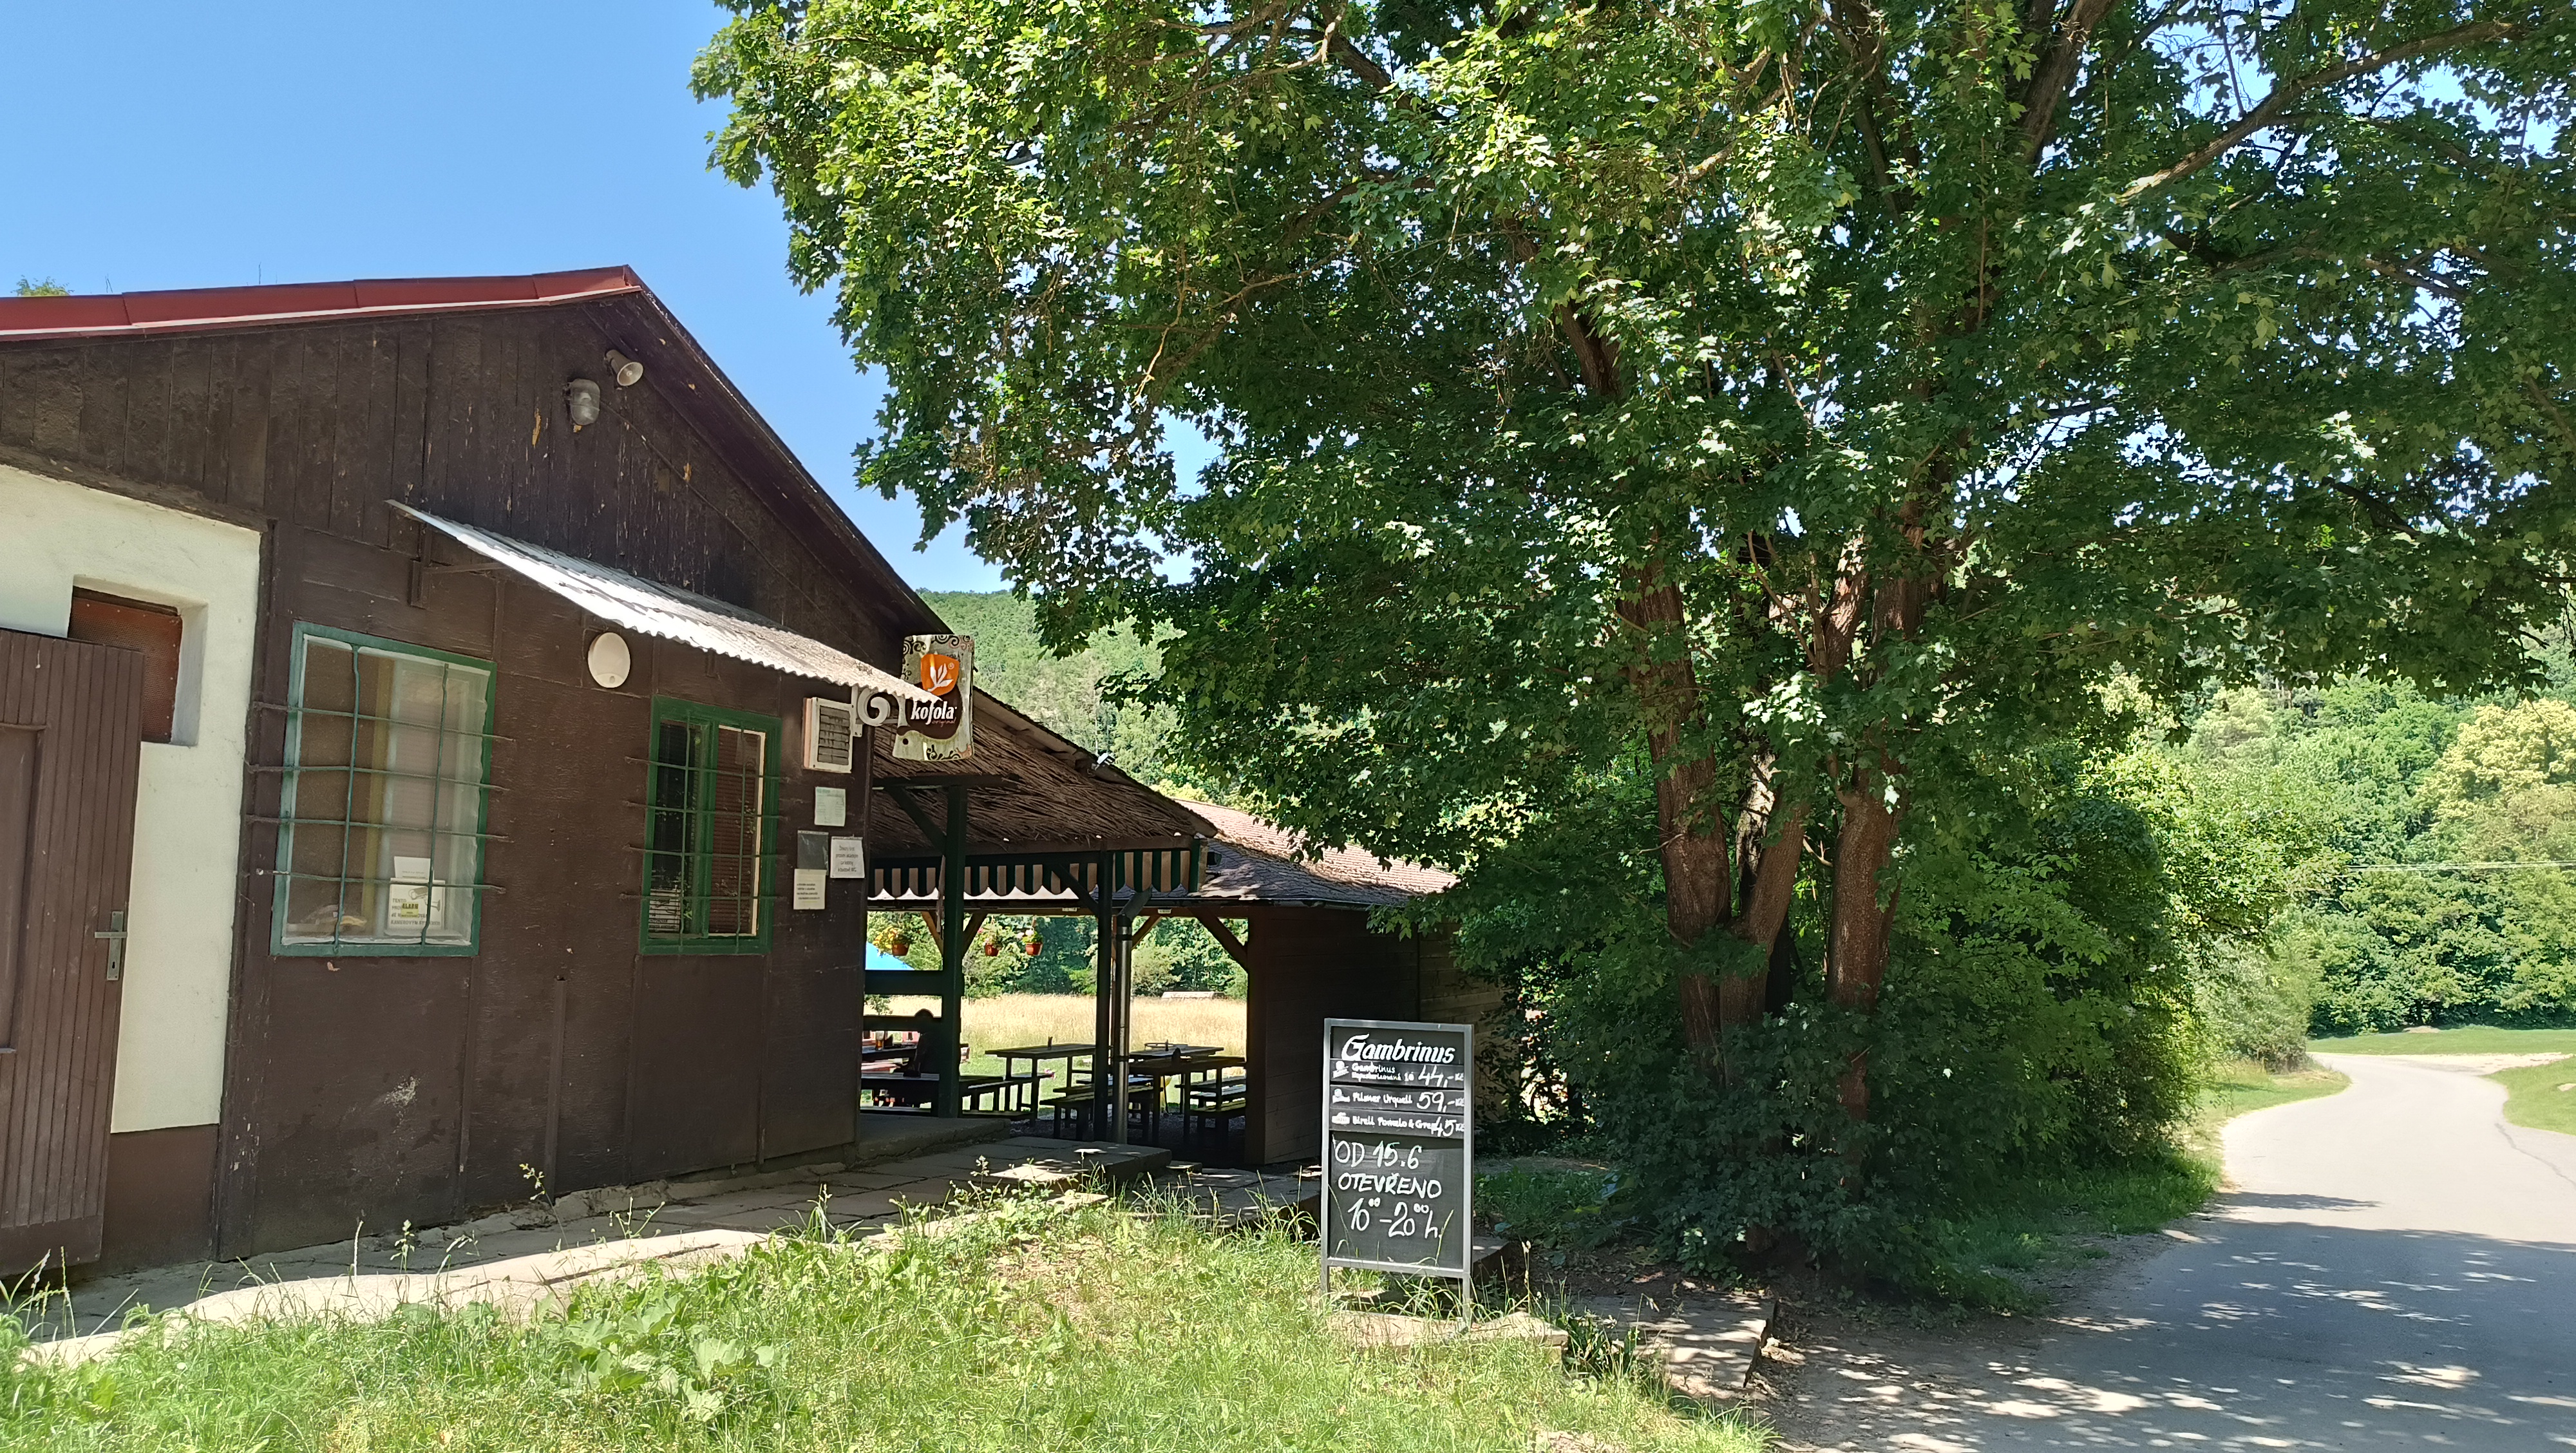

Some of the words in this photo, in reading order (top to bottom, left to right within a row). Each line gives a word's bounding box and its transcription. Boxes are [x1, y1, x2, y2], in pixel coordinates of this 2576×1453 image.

[911, 701, 954, 725] kofola
[932, 717, 957, 728] original
[1341, 1032, 1455, 1063] Gambrinus
[1352, 1061, 1396, 1074] Gambrinus
[1352, 1092, 1381, 1103] Pilsner
[1383, 1094, 1413, 1108] Urquell
[1431, 1116, 1457, 1137] 45
[1334, 1140, 1365, 1168] OD
[1372, 1140, 1422, 1170] 15.6
[1338, 1172, 1442, 1199] OTEVŘENO
